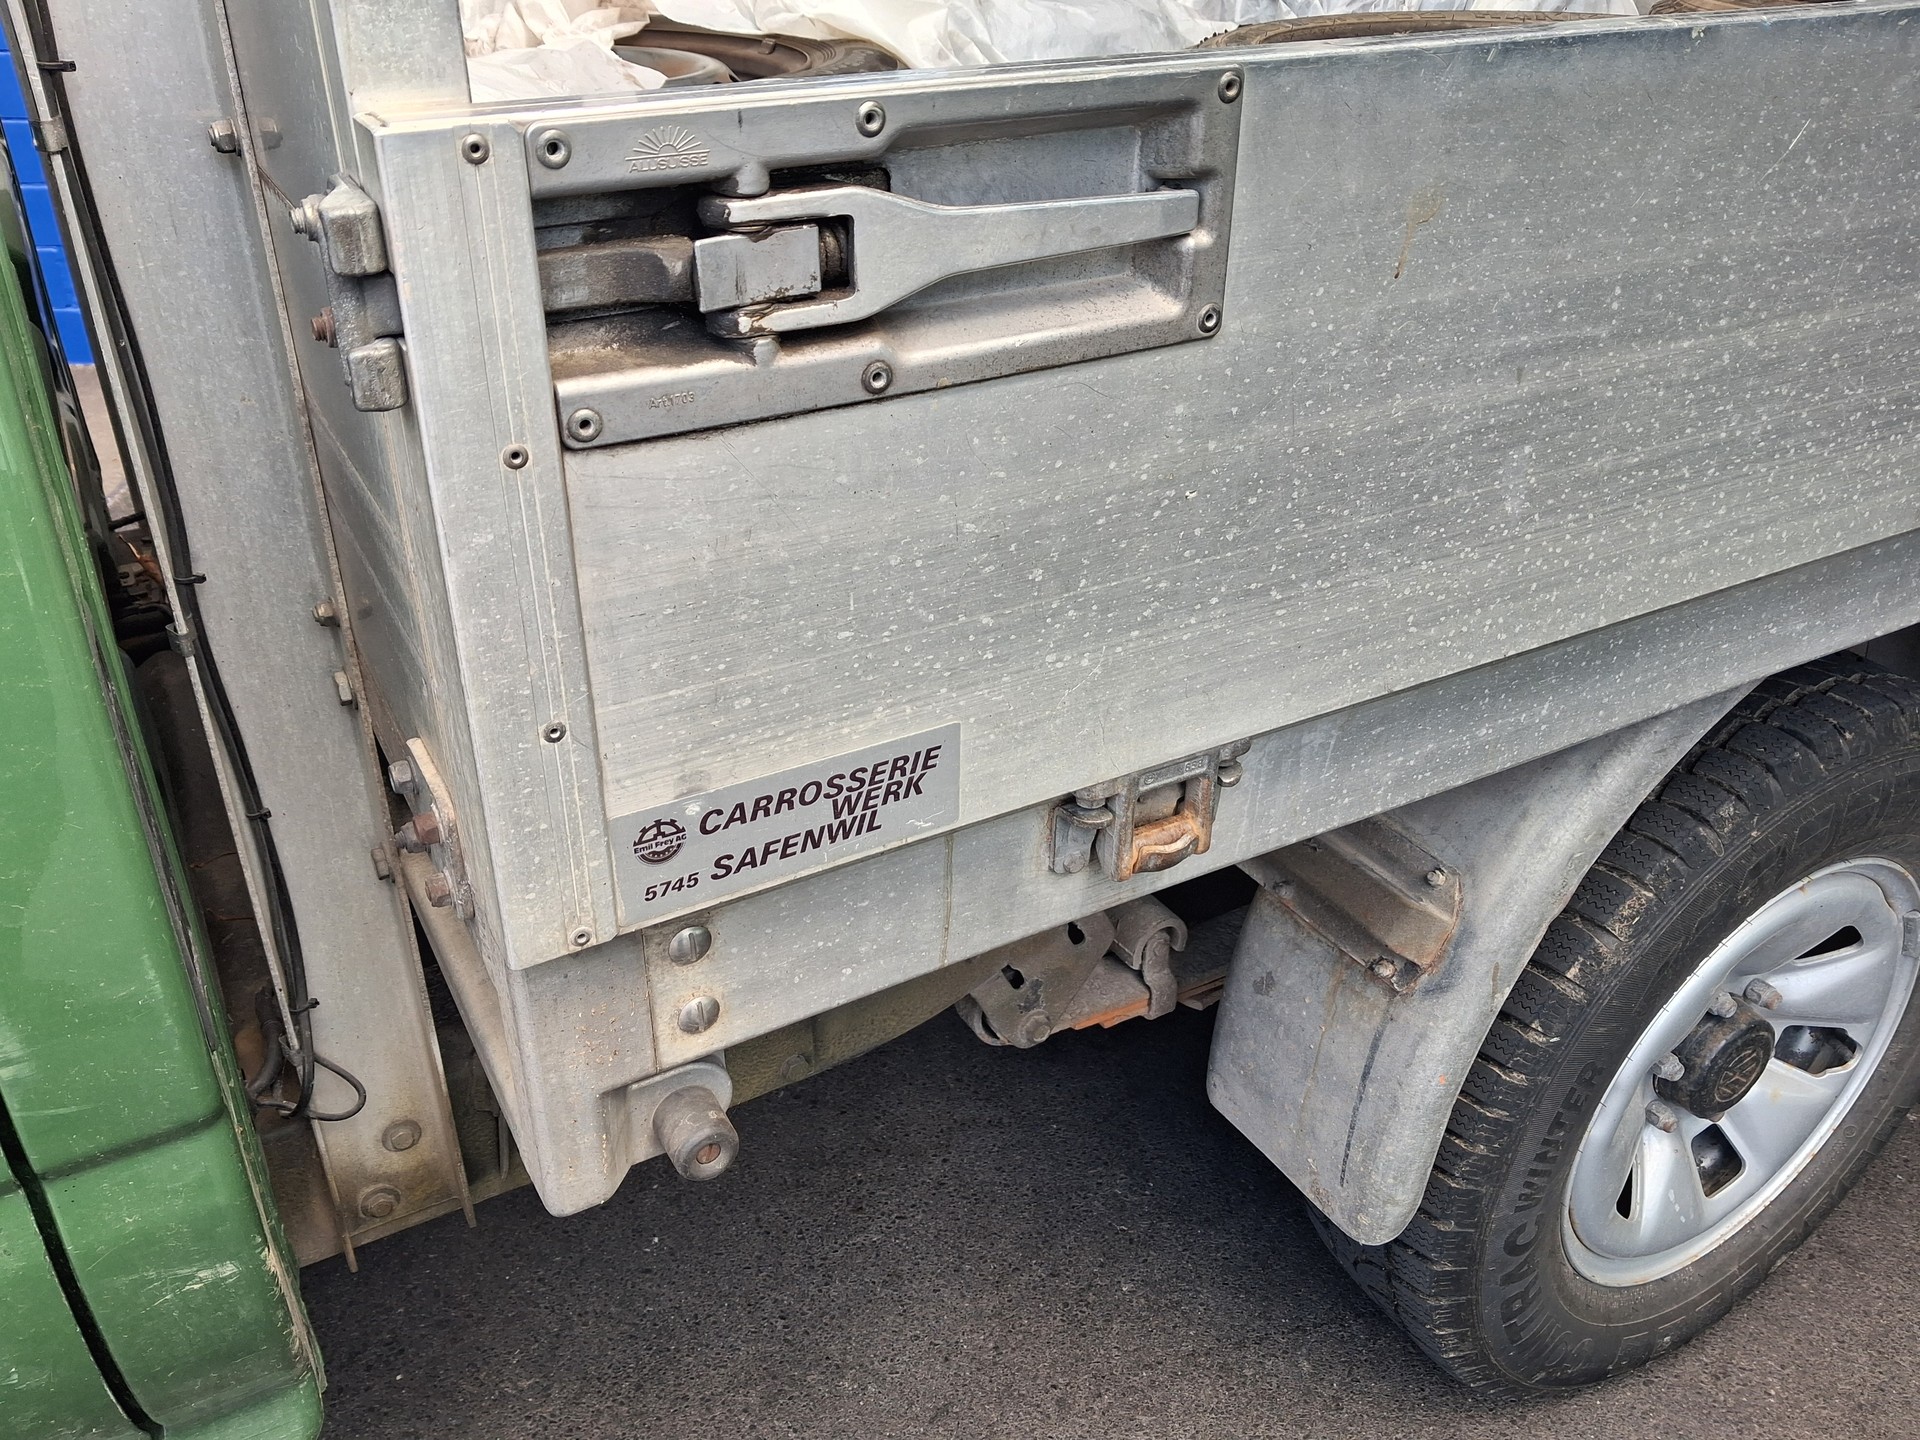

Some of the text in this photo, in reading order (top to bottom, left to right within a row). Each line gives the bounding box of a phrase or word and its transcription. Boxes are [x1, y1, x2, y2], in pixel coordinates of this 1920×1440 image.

[700, 744, 943, 836] CARROSSERIE
[831, 772, 929, 820] WERK
[634, 842, 653, 855] Emil
[655, 837, 675, 849] Frey
[643, 809, 882, 902] 5745 SAFENWIL
[1514, 1060, 1607, 1214] WINTER
